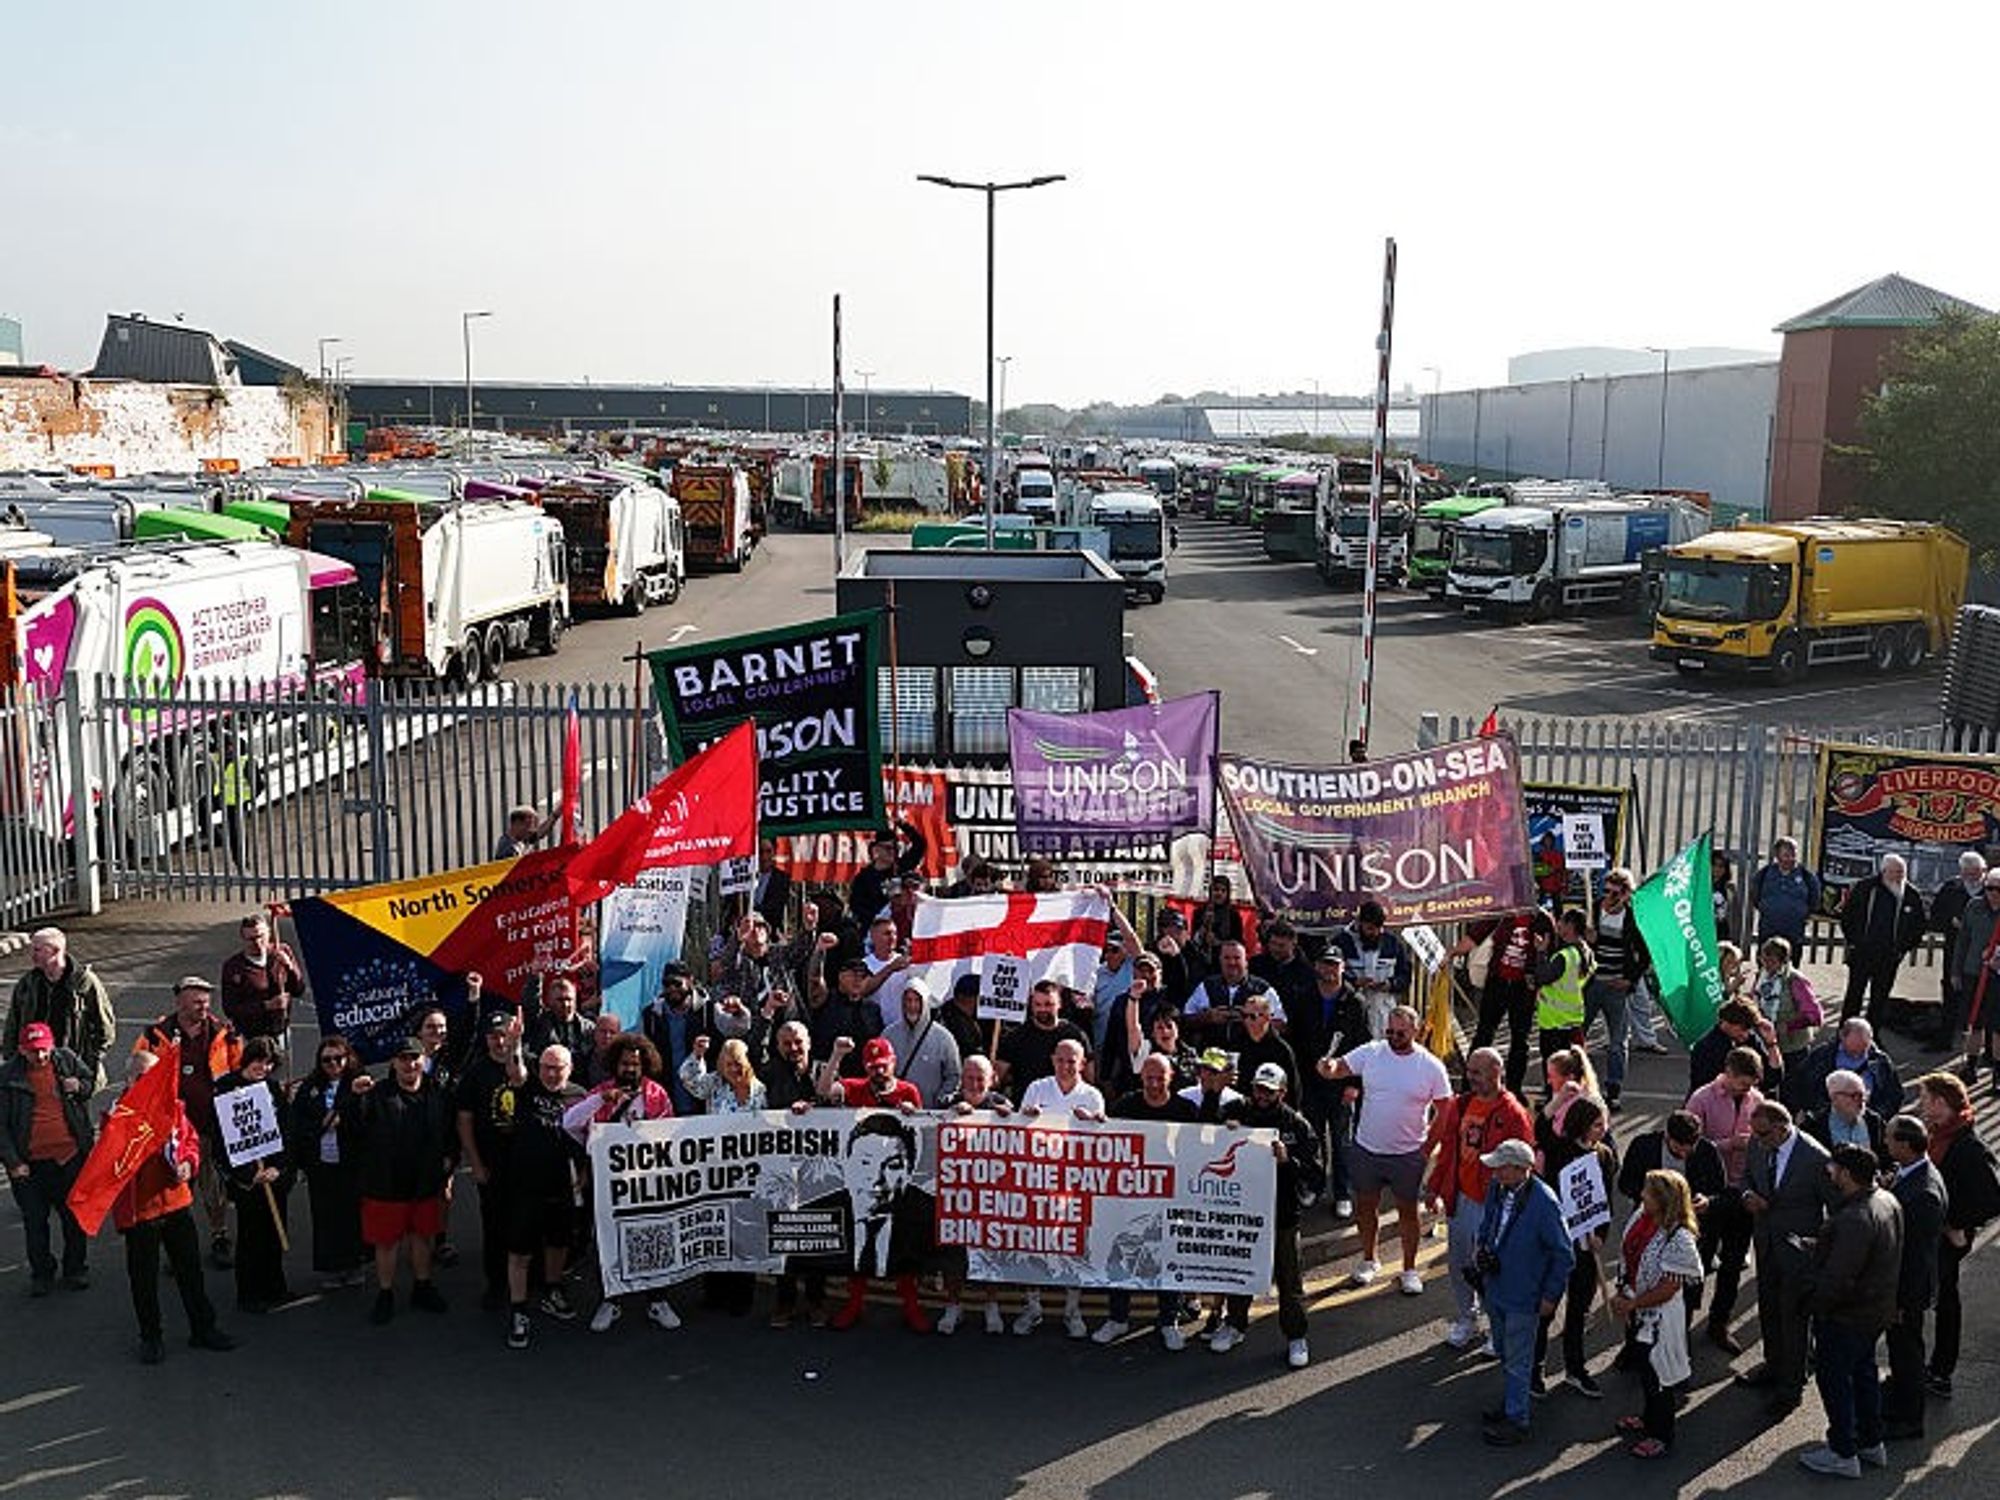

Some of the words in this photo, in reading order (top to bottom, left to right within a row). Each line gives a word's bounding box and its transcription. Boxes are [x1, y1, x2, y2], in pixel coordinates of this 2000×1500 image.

[193, 608, 213, 628] ACT
[213, 596, 267, 623] TOGETHER
[193, 629, 215, 649] FOR
[227, 614, 272, 640] CLEANER
[193, 639, 261, 670] BIRMINGHAM
[674, 632, 861, 698] BARNET
[682, 692, 735, 714] LOCAL
[744, 664, 857, 700] GOVERNMENT
[760, 768, 842, 796] ALITY
[1047, 758, 1187, 797] UNISON
[1221, 742, 1508, 799] SOUTHEND-ON-SEA
[1243, 797, 1294, 816] LOCAL
[1299, 800, 1415, 818] GOVERNMENT
[1421, 781, 1491, 807] BRANCH
[973, 832, 1064, 861] UNDER
[1069, 832, 1169, 860] ATTACK
[1272, 838, 1476, 895] UNISON
[389, 888, 458, 920] North
[1393, 902, 1425, 917] and
[1427, 895, 1493, 914] Services
[1674, 898, 1707, 968] Green
[609, 1140, 673, 1172] SICK
[680, 1137, 714, 1165] OF
[721, 1130, 839, 1160] RUBBISH
[940, 1127, 1025, 1155] C'MON
[1031, 1131, 1139, 1167] COTTON,
[610, 1169, 701, 1206] PILING
[708, 1161, 761, 1191] UP?
[940, 1159, 1006, 1184] STOP
[1011, 1161, 1059, 1190] THE
[1064, 1166, 1111, 1192] PAY
[1117, 1168, 1168, 1194] CUT
[1188, 1174, 1241, 1198] unite
[680, 1209, 714, 1230] SEND
[716, 1208, 725, 1223] A
[940, 1188, 973, 1213] TO
[979, 1190, 1027, 1219] END
[1032, 1194, 1082, 1222] THE
[1208, 1211, 1264, 1228] FIGHTING
[939, 1219, 982, 1245] BIN
[986, 1222, 1077, 1251] STRIKE
[1169, 1224, 1193, 1238] FOR
[1195, 1227, 1225, 1240] JOBS
[681, 1240, 727, 1266] HERE
